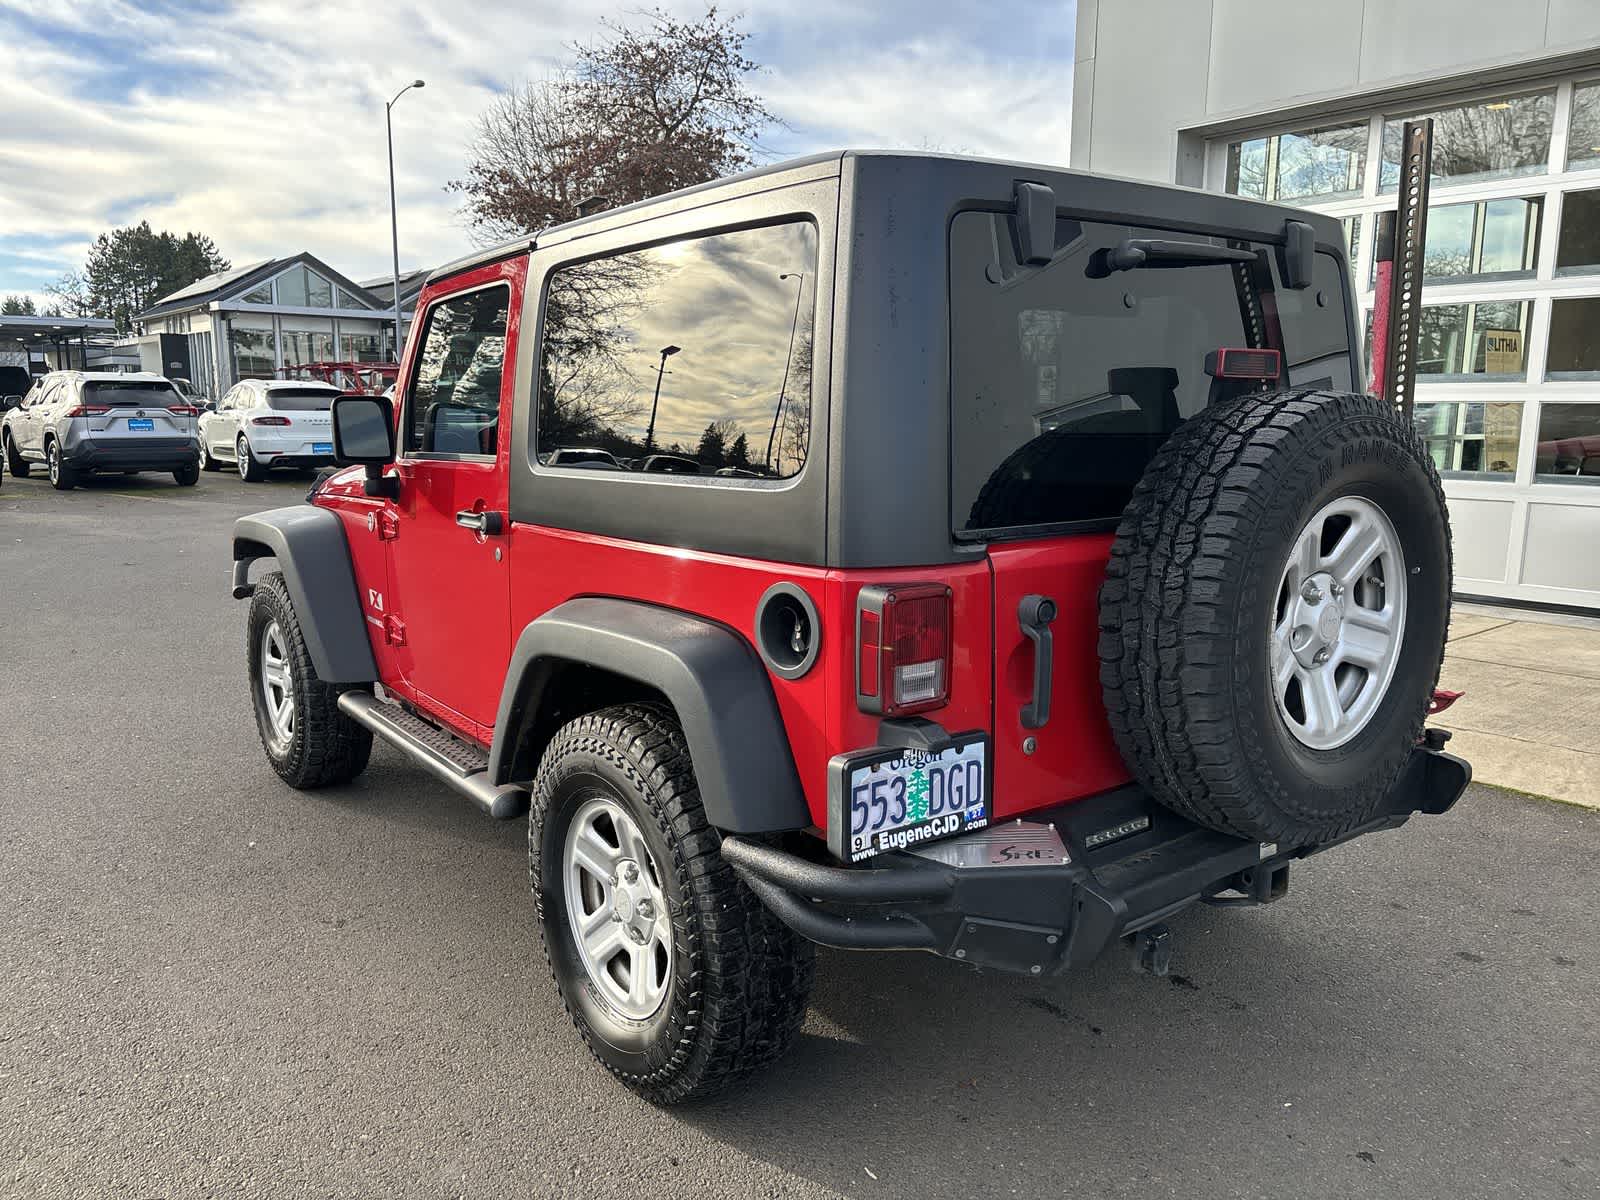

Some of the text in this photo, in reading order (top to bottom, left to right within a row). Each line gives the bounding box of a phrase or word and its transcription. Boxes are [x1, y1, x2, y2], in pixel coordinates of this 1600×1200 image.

[1494, 337, 1518, 353] LITHIA
[852, 759, 982, 835] 553 DGD
[851, 814, 988, 862] www. EugeneCJD .com
